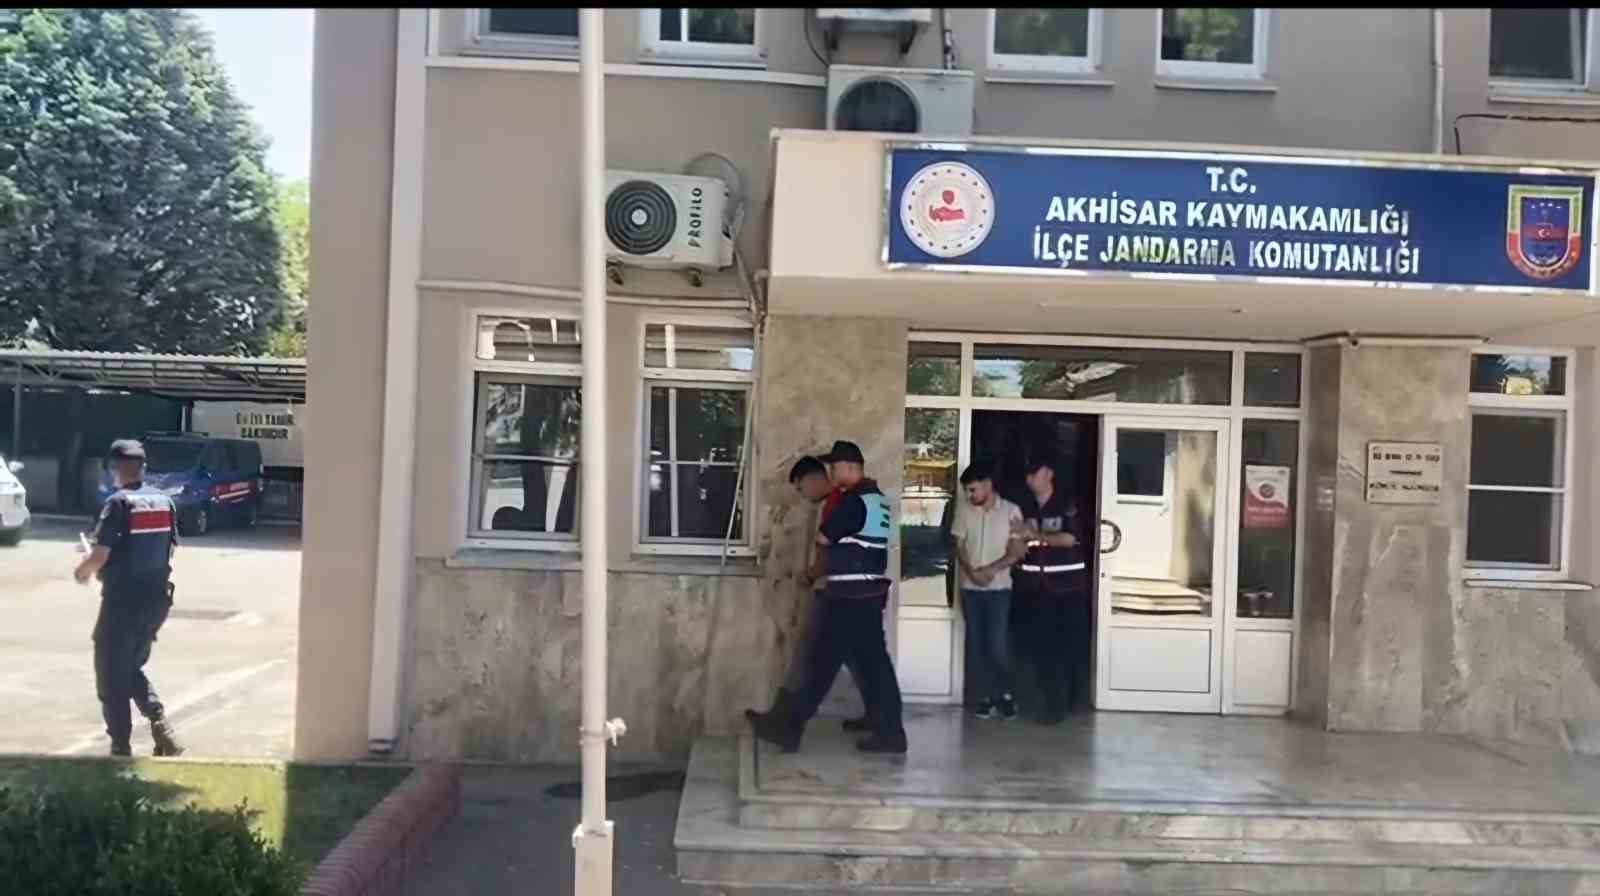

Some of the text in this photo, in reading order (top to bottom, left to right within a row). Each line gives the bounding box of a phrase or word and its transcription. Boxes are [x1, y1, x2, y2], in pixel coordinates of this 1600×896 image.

[1206, 167, 1257, 194] T.C.
[1045, 191, 1410, 236] AKHİSAR KAYMAKAMLIĞI
[1034, 225, 1420, 274] İLÇE JANDARMA KOMUTANLIĞI
